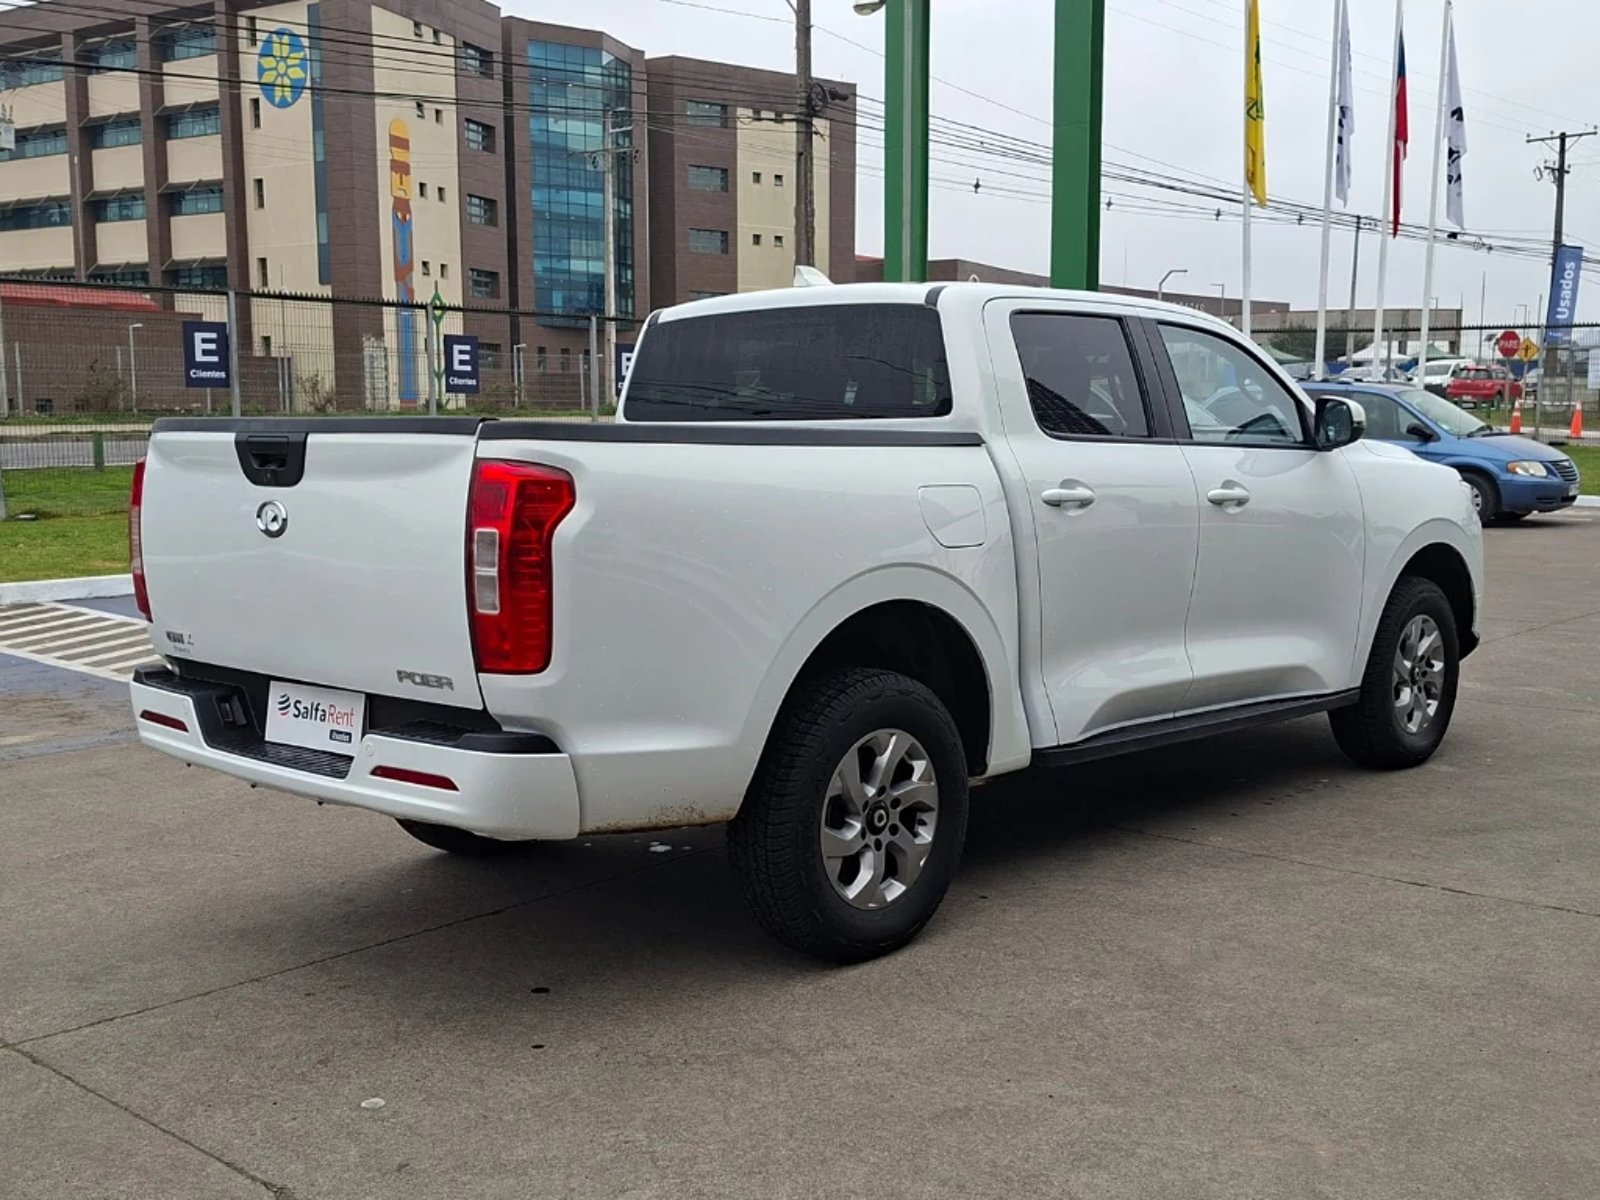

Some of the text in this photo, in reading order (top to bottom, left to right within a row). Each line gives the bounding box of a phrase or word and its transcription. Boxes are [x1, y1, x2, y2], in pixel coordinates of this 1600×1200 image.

[1556, 261, 1576, 319] Usados
[194, 332, 219, 362] E
[452, 344, 472, 371] E
[190, 369, 226, 379] Clientes
[293, 699, 355, 728] SalfaRent
